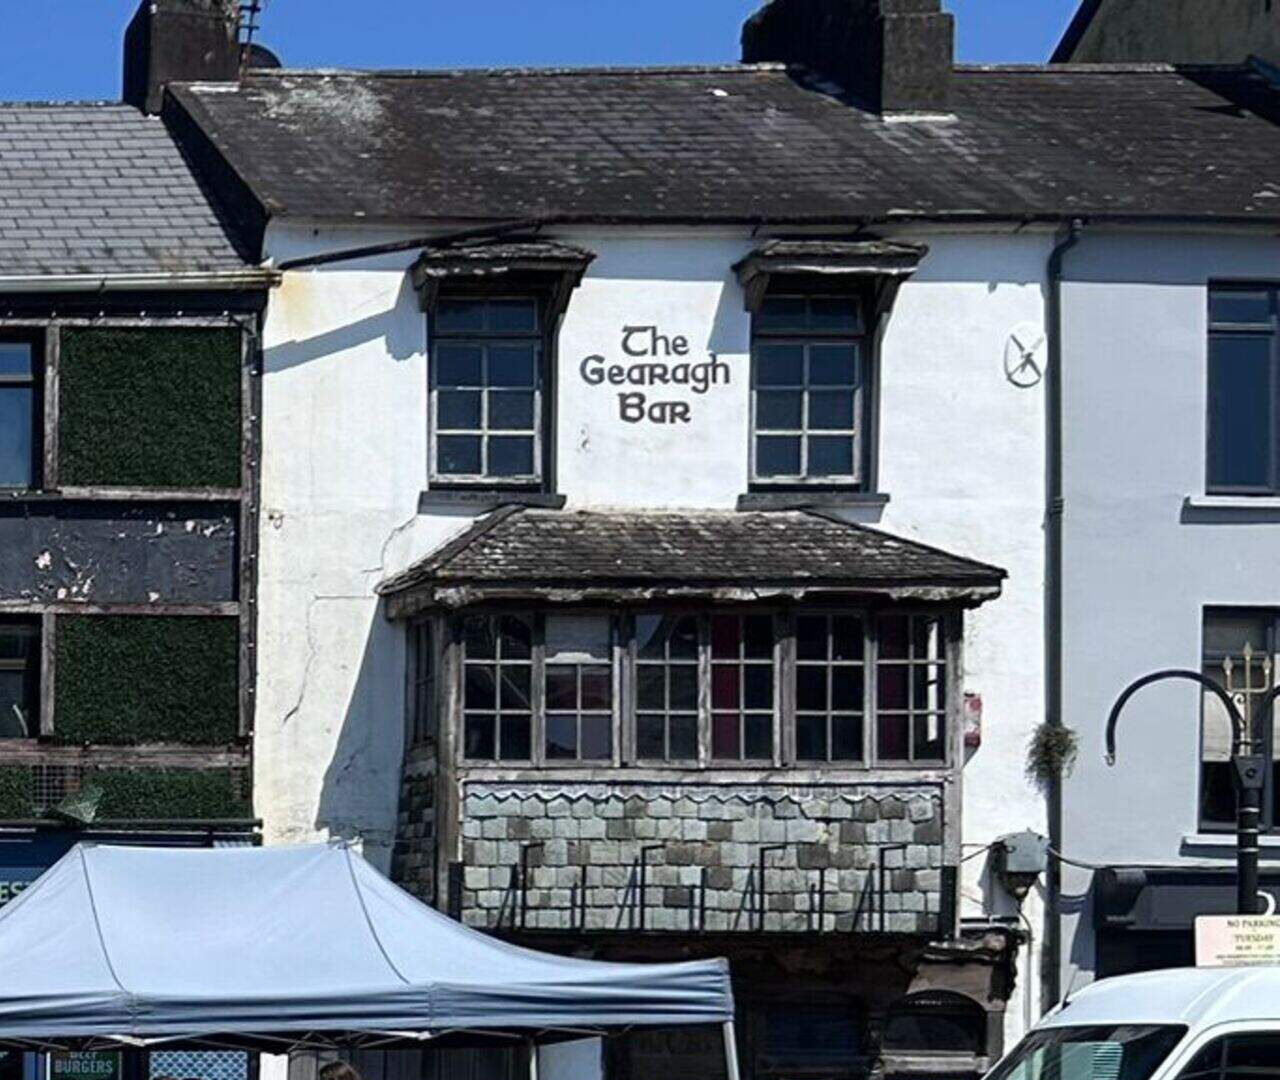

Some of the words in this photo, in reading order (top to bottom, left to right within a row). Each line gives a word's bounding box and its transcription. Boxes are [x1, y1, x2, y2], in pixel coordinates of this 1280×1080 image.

[621, 325, 689, 356] The
[579, 353, 731, 394] Gearagh
[617, 392, 692, 424] Bar
[54, 1060, 114, 1074] BURGERS
